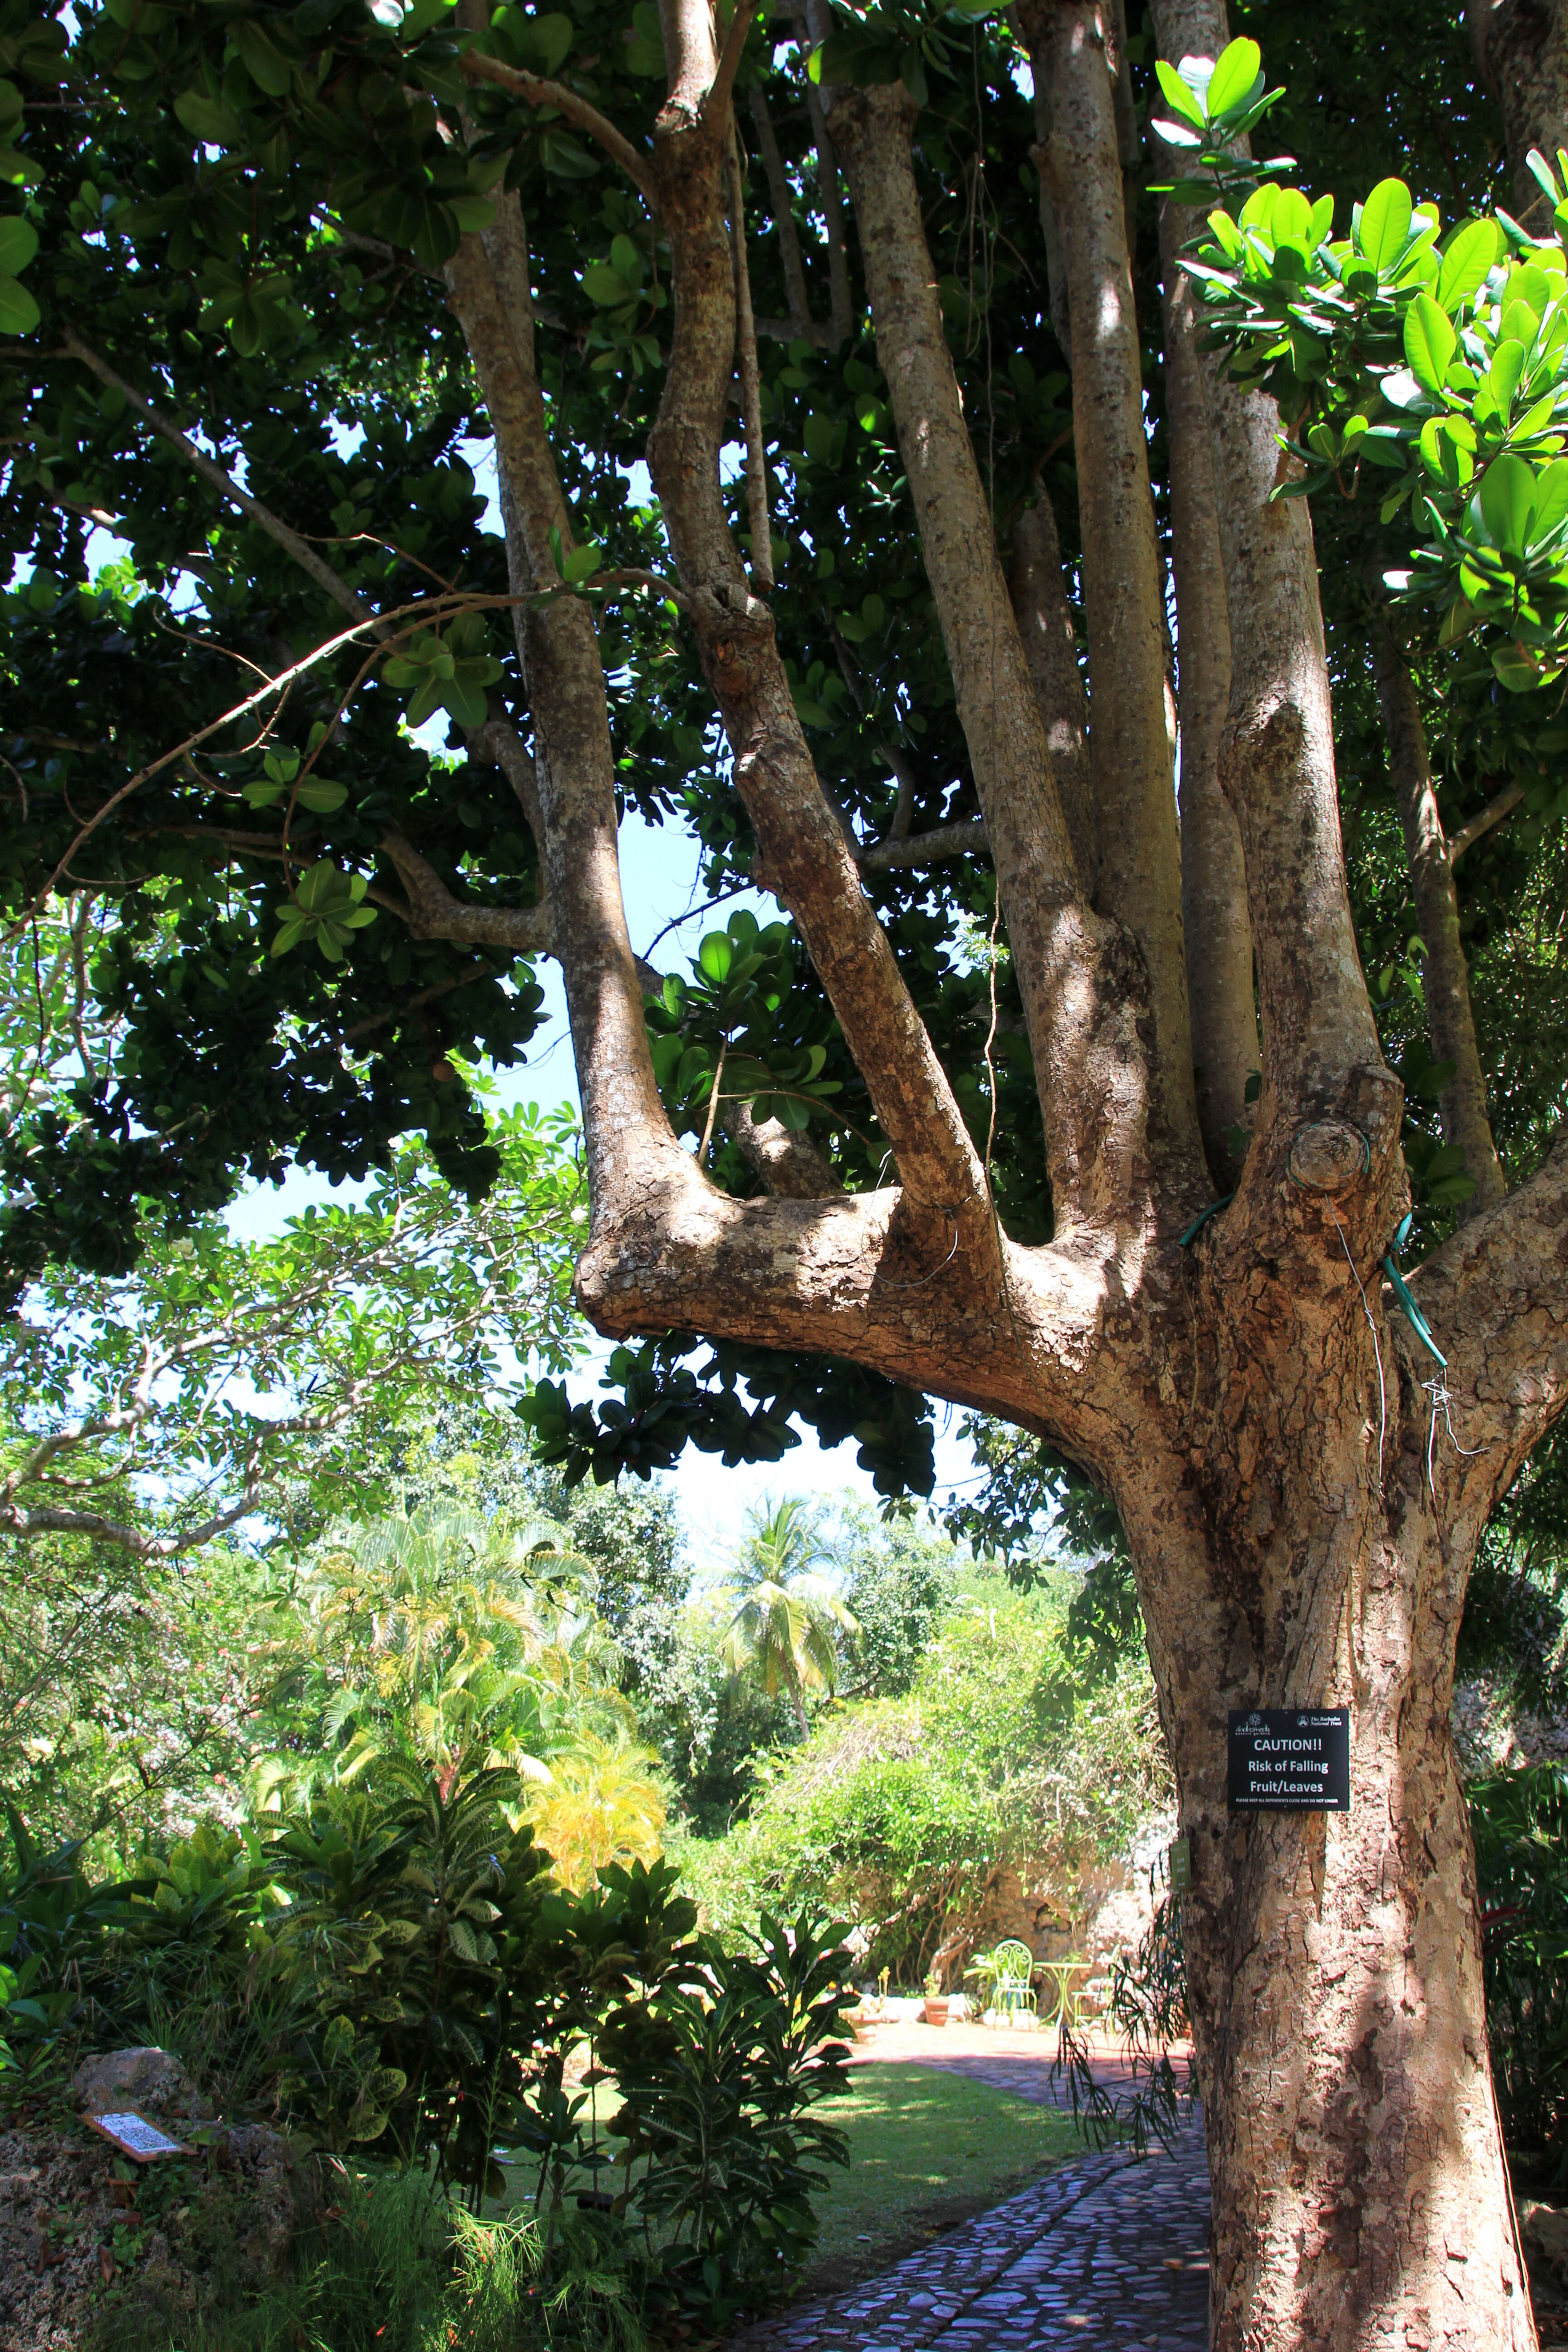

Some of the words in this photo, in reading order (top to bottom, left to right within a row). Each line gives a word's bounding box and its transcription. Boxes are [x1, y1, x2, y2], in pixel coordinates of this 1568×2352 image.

[1254, 1739, 1322, 1750] CAUTION!!
[1248, 1760, 1272, 1772] Risk
[1275, 1760, 1288, 1772] of
[1290, 1760, 1329, 1774] Falling
[1250, 1780, 1323, 1794] Fruit/Leaves
